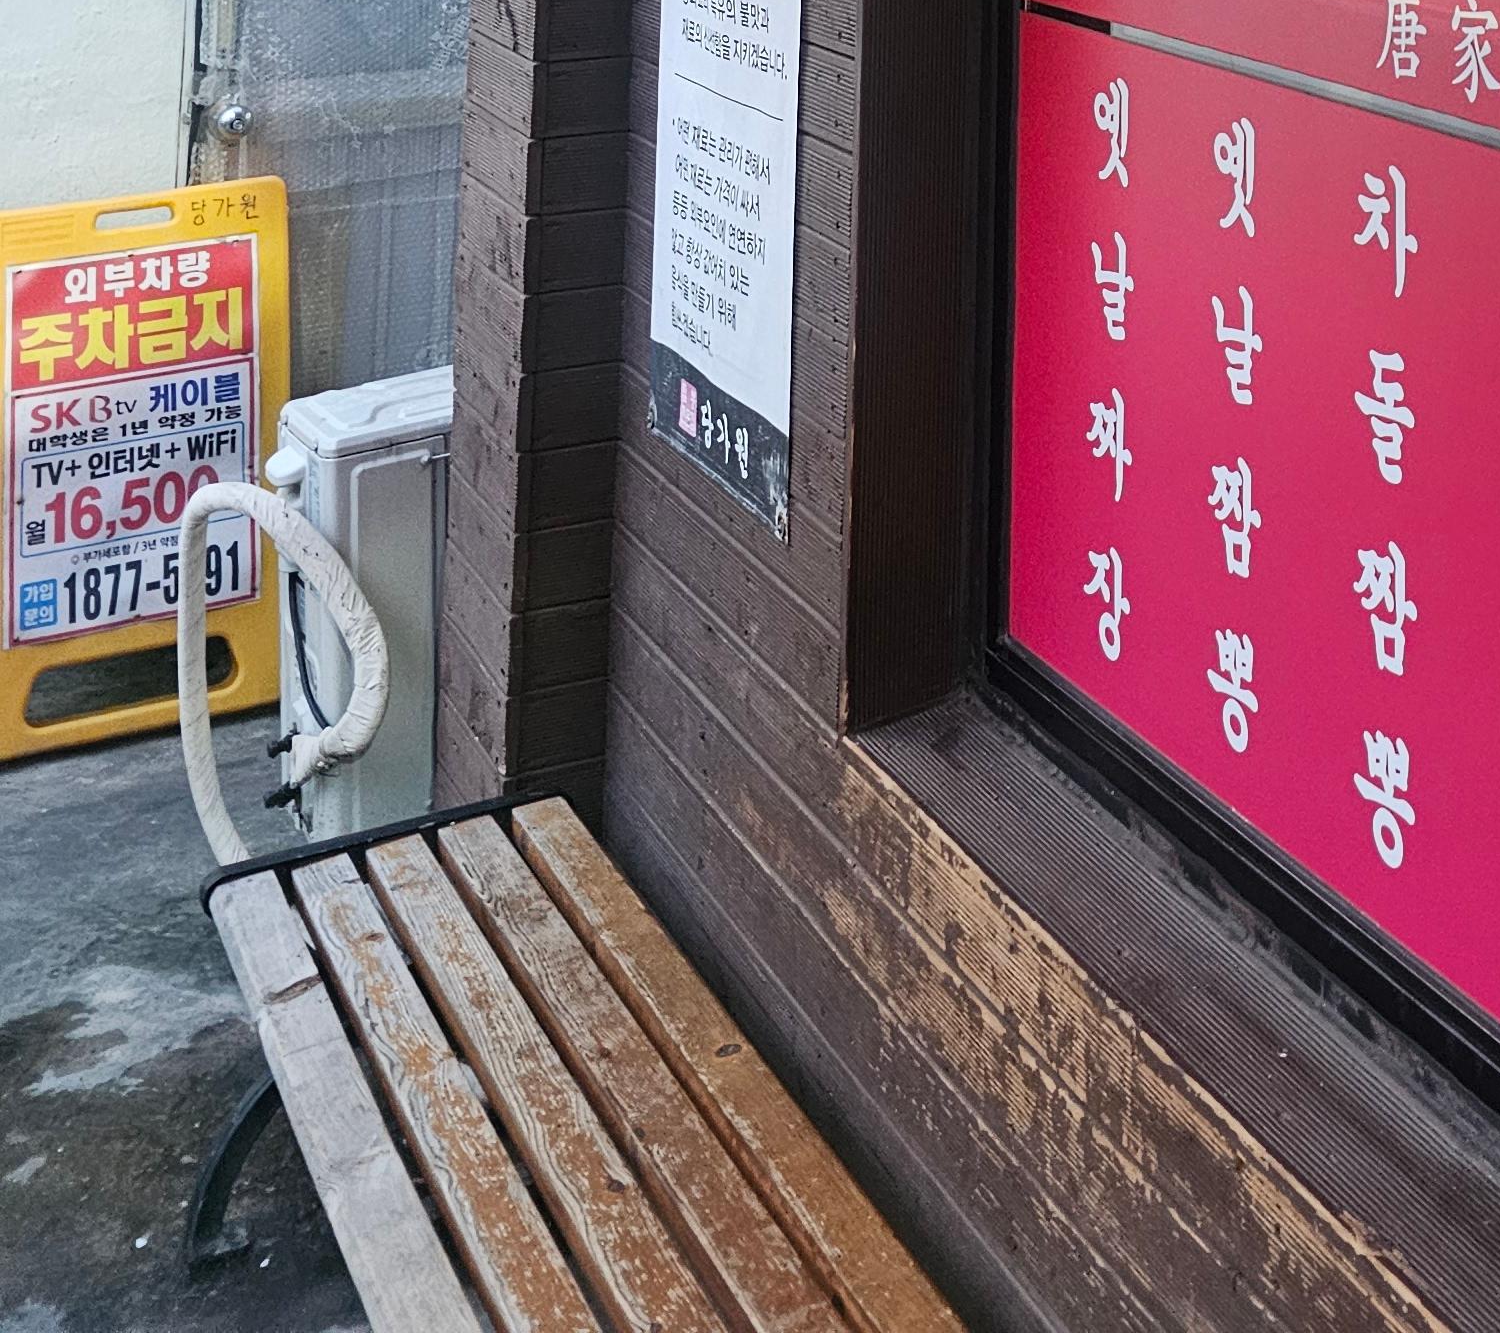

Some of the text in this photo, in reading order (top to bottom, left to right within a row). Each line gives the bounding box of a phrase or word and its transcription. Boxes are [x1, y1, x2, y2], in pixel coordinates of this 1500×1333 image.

[190, 193, 260, 227] 당가원
[63, 250, 211, 305] 외부차량
[18, 286, 245, 382] 주차금지
[1083, 76, 1134, 663] 옛날짜장
[27, 402, 241, 454] 대학생은 1년 약정 가능
[29, 399, 85, 434] SK
[148, 372, 241, 413] 케이블
[188, 430, 238, 462] WiFi
[700, 400, 748, 479] 당가원
[1207, 116, 1263, 754] 옛날짬뽕
[24, 518, 47, 545] 월
[1352, 165, 1418, 873] 차돌짬뽕
[141, 539, 157, 555] 3년
[23, 581, 54, 603] 가입
[63, 539, 240, 626] 1877-591
[23, 604, 54, 627] 문의
